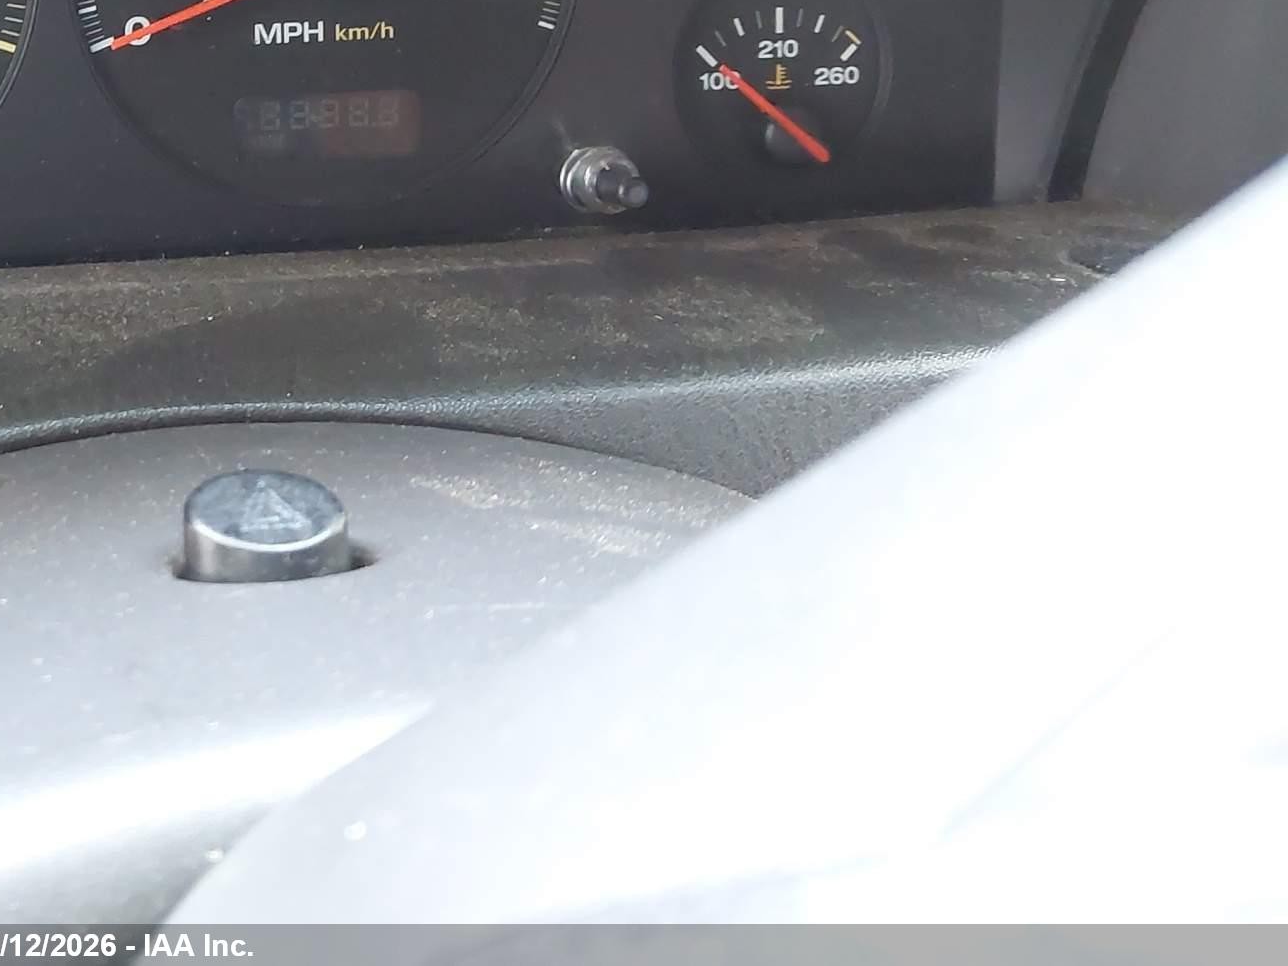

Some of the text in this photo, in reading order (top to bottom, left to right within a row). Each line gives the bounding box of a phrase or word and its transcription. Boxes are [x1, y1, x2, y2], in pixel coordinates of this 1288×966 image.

[125, 17, 151, 45] 0
[255, 21, 393, 44] MPH km/h
[758, 40, 798, 58] 210
[700, 72, 741, 90] 100
[815, 66, 859, 85] 260
